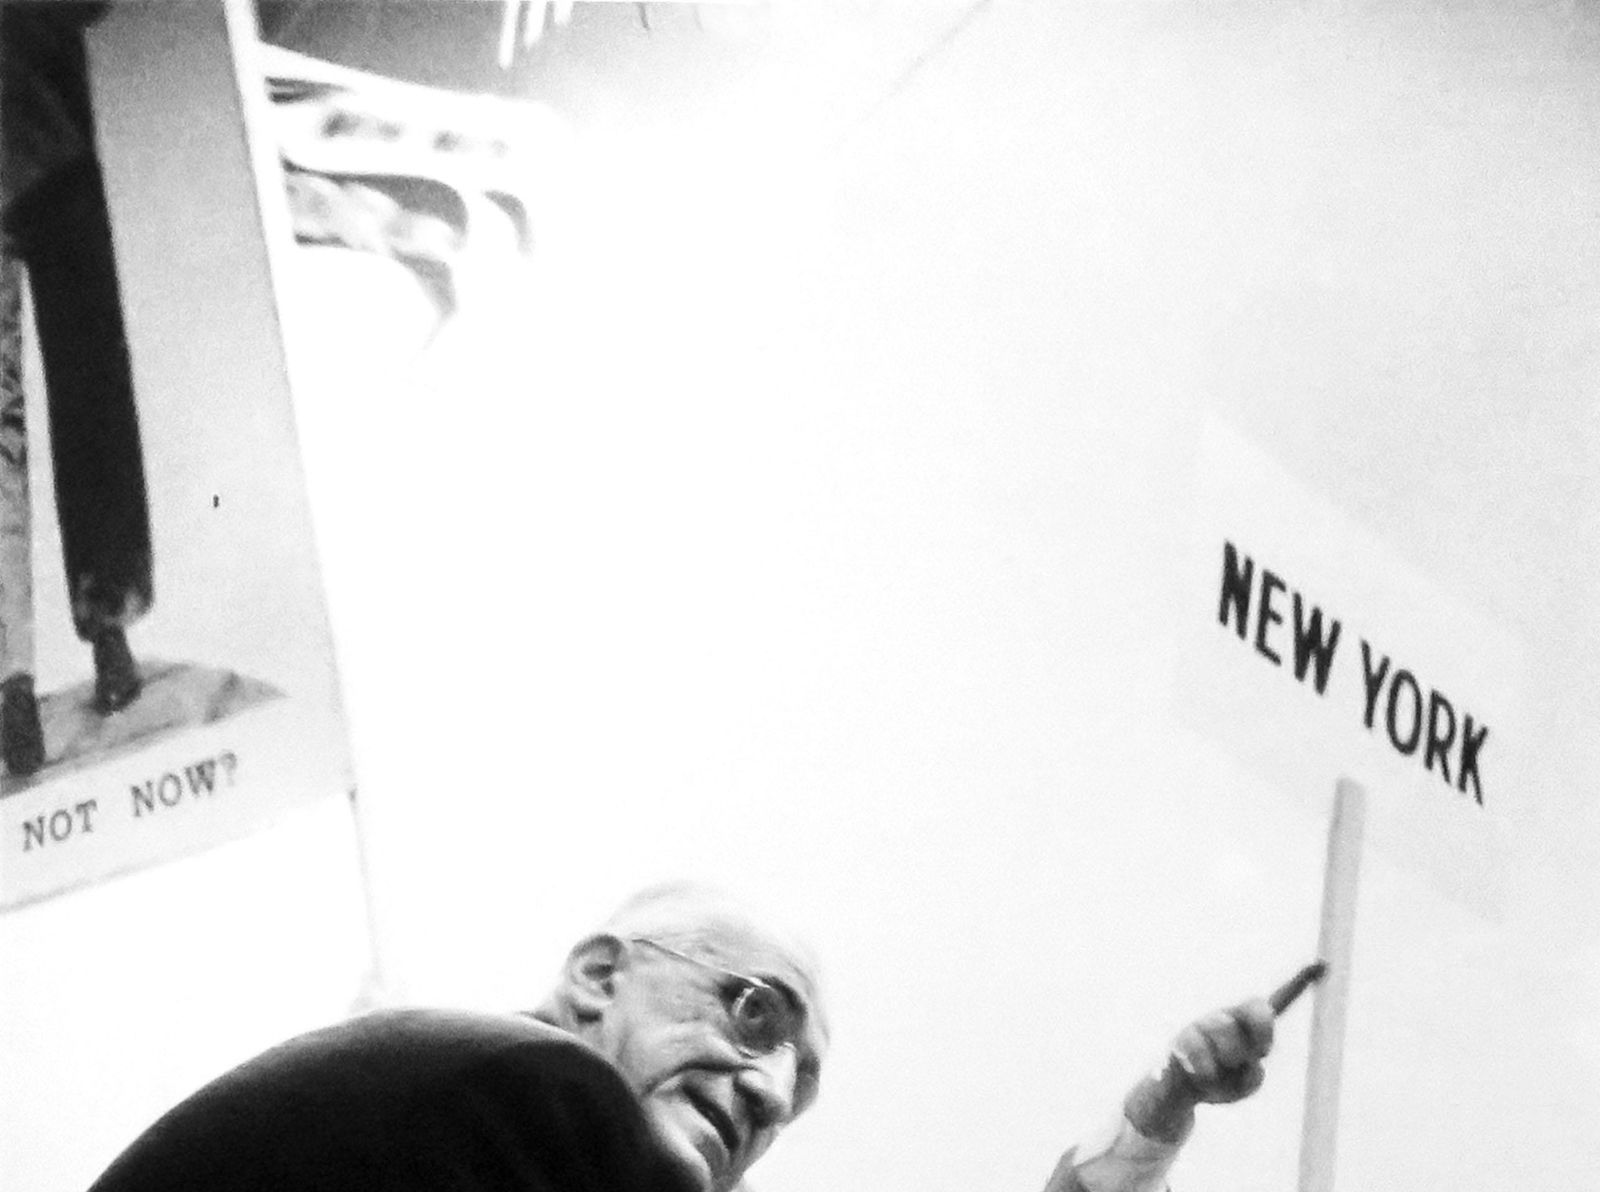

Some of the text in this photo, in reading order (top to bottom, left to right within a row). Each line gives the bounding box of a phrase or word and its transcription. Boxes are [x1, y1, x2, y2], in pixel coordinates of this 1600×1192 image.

[1218, 541, 1488, 805] NEW YORK
[22, 751, 237, 851] NOT NOW?
